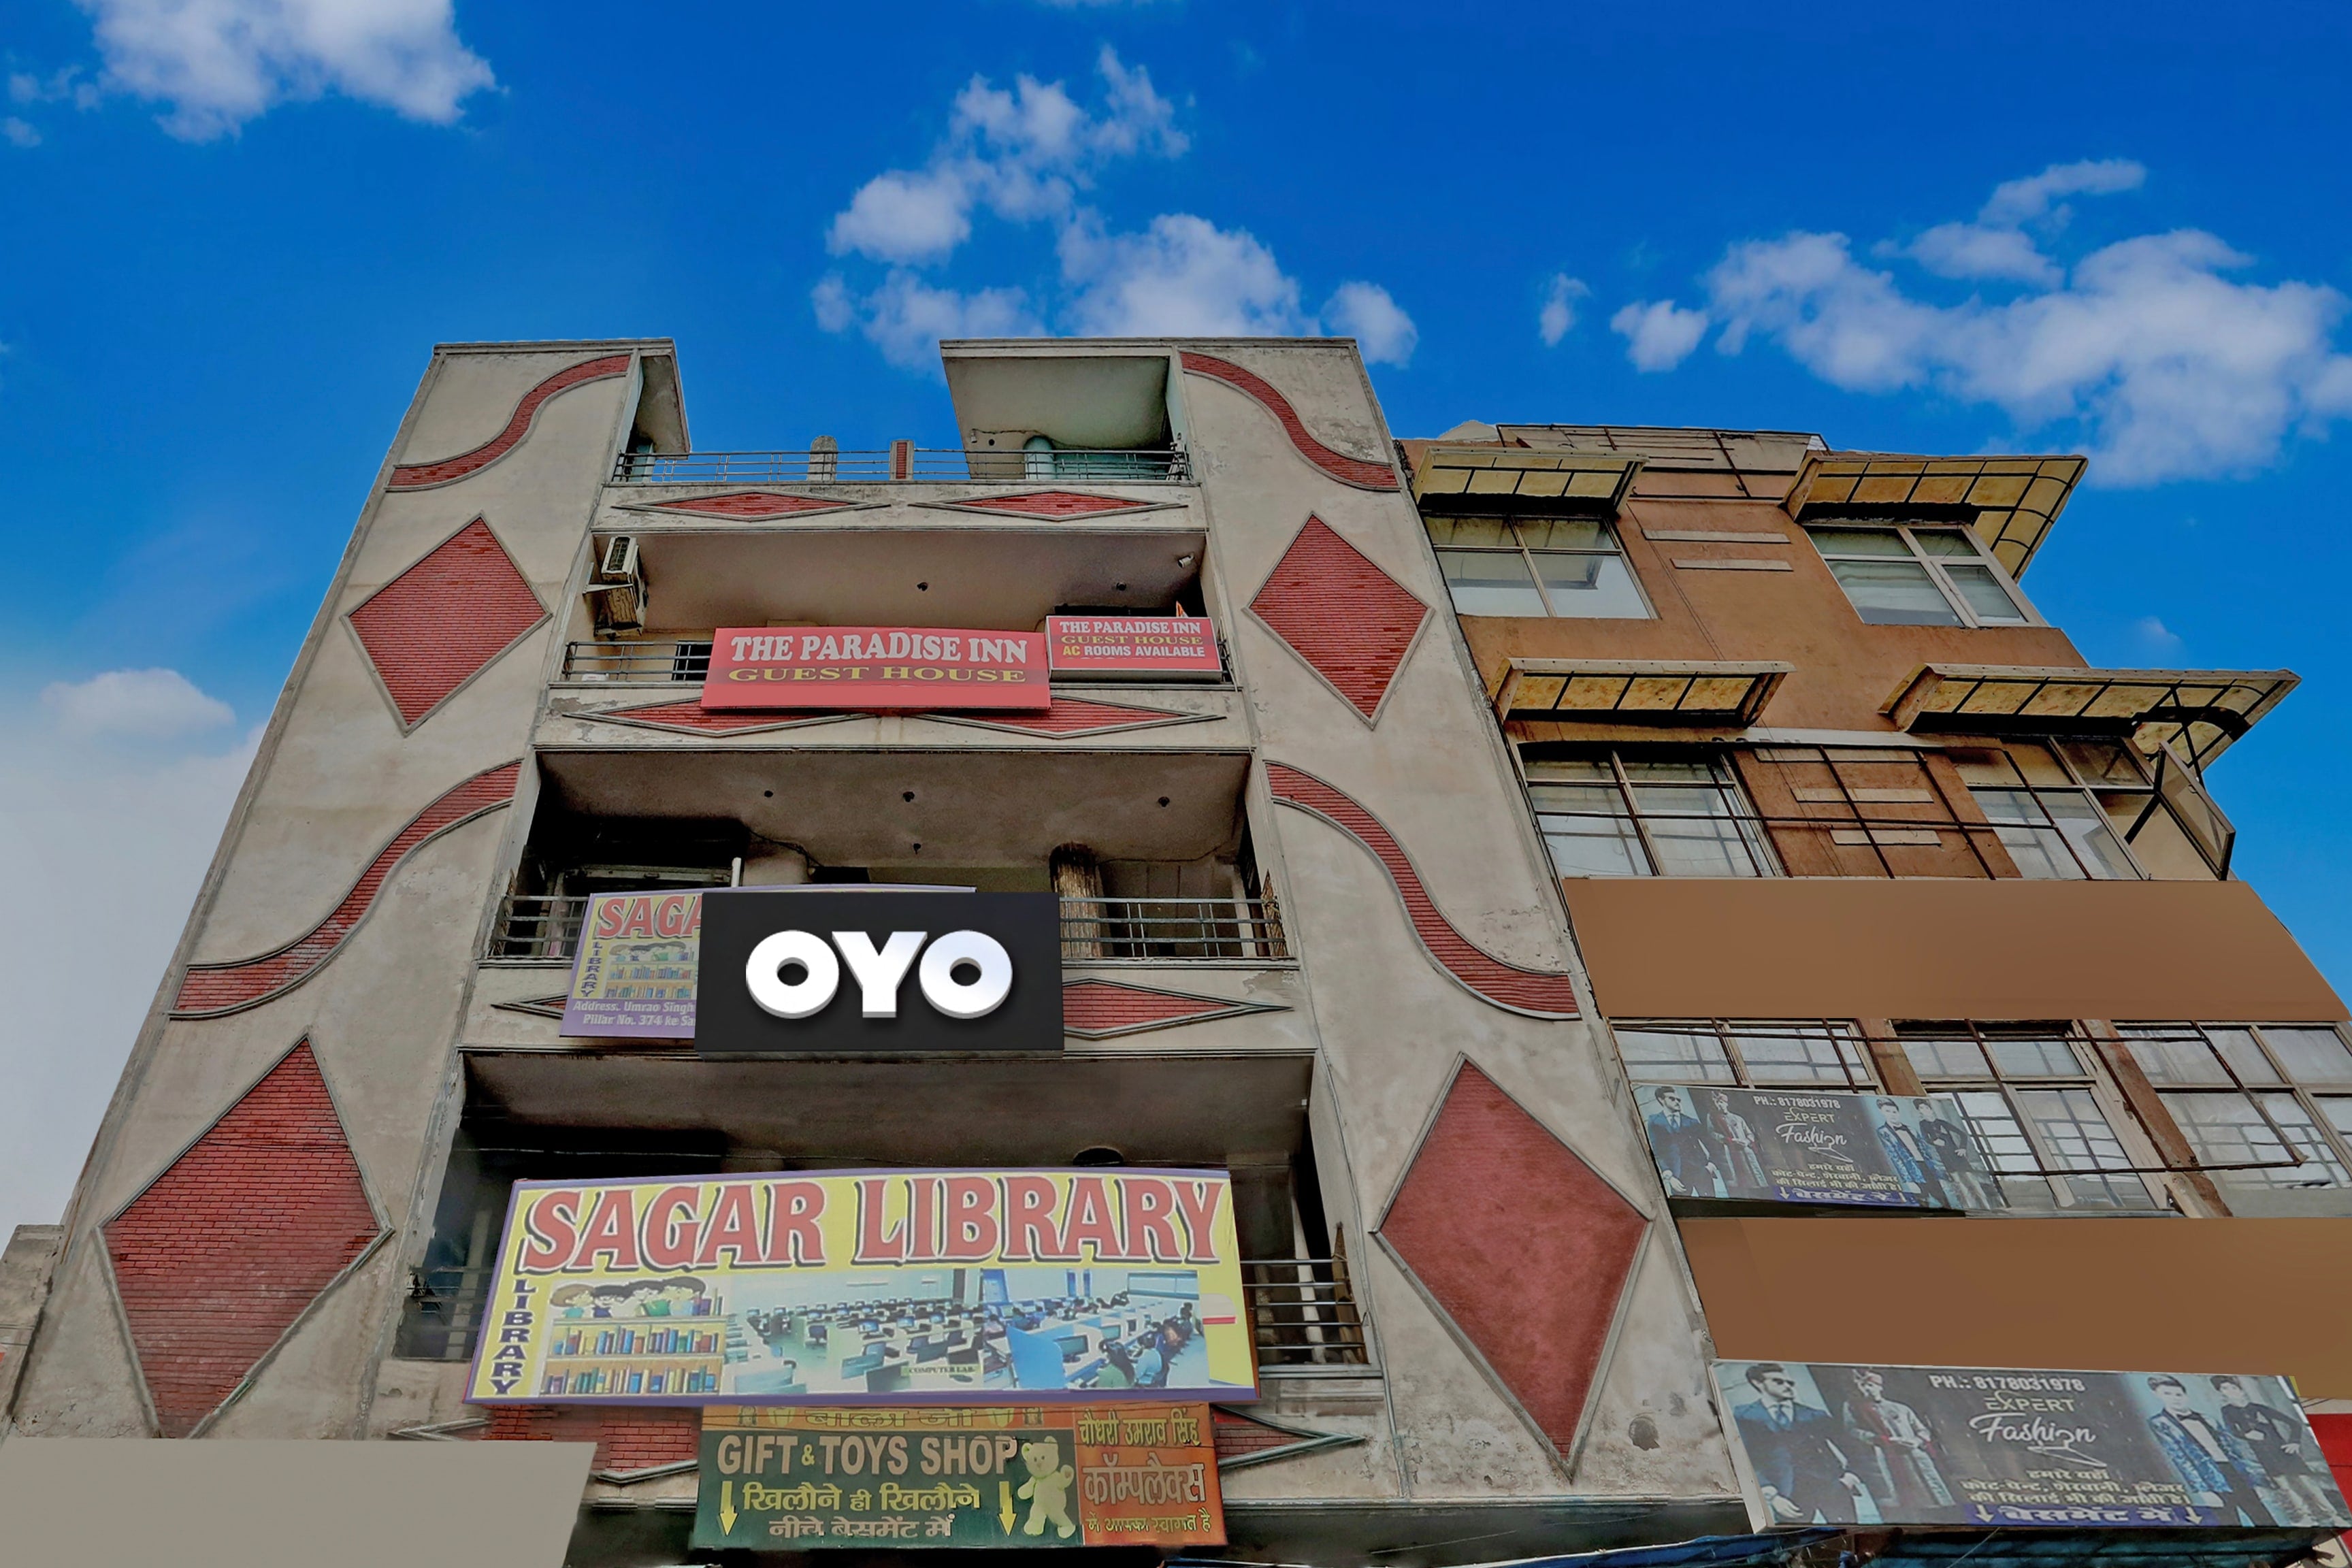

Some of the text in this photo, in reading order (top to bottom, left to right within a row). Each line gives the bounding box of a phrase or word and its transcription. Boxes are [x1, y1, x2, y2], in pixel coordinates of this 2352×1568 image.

[1059, 621, 1200, 634] THE PARADISE INN
[730, 632, 1028, 664] THE PARADISE INN
[1060, 635, 1203, 644] GUEST HOUSE
[1062, 646, 1205, 657] AC ROOMS AVAILABLE
[728, 666, 1026, 683] GUEST HOUSE
[581, 941, 603, 997] LIBRARY
[746, 930, 1013, 1019] OYO
[623, 1002, 660, 1012] Umrao
[583, 1013, 615, 1024] Pillar
[638, 1015, 663, 1026] 374
[665, 1015, 680, 1026] ke
[1777, 1096, 1841, 1109] 8178031978
[1782, 1107, 1835, 1122] EXPERT
[514, 1175, 1224, 1275] SAGAR LIBRARY
[489, 1279, 538, 1395] LIBRARY
[1973, 1375, 2086, 1392] 8178031978
[1983, 1390, 2076, 1411] EXPERT
[717, 1435, 1019, 1475] GIFT & TOYS SHOP
[742, 1482, 843, 1511] खिलौने
[849, 1489, 872, 1511] ही
[768, 1515, 826, 1537] नीचे
[1198, 1507, 1211, 1531] है
